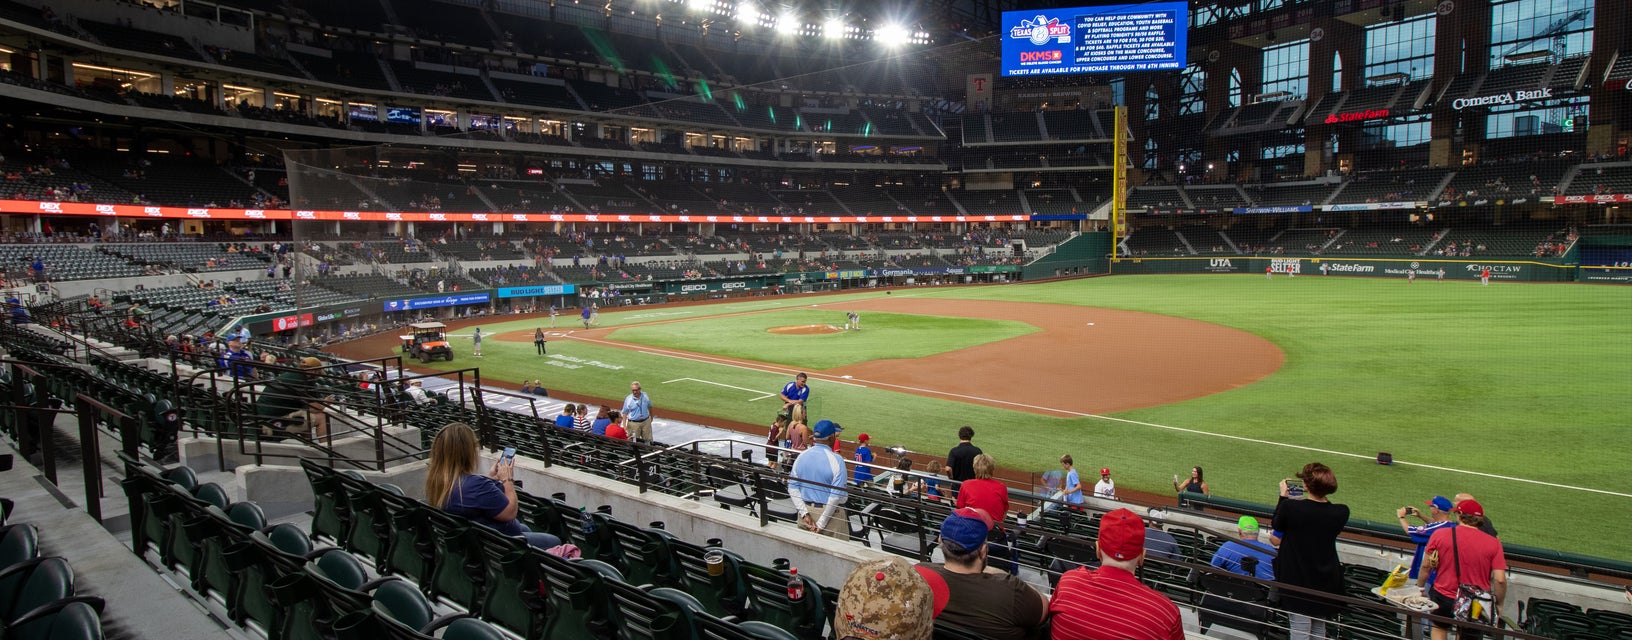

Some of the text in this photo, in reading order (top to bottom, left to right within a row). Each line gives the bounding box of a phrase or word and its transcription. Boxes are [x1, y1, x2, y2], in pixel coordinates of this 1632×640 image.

[1021, 51, 1051, 62] DKMS
[1516, 87, 1552, 102] Bank
[1210, 258, 1231, 267] UTA
[649, 465, 656, 476] 21
